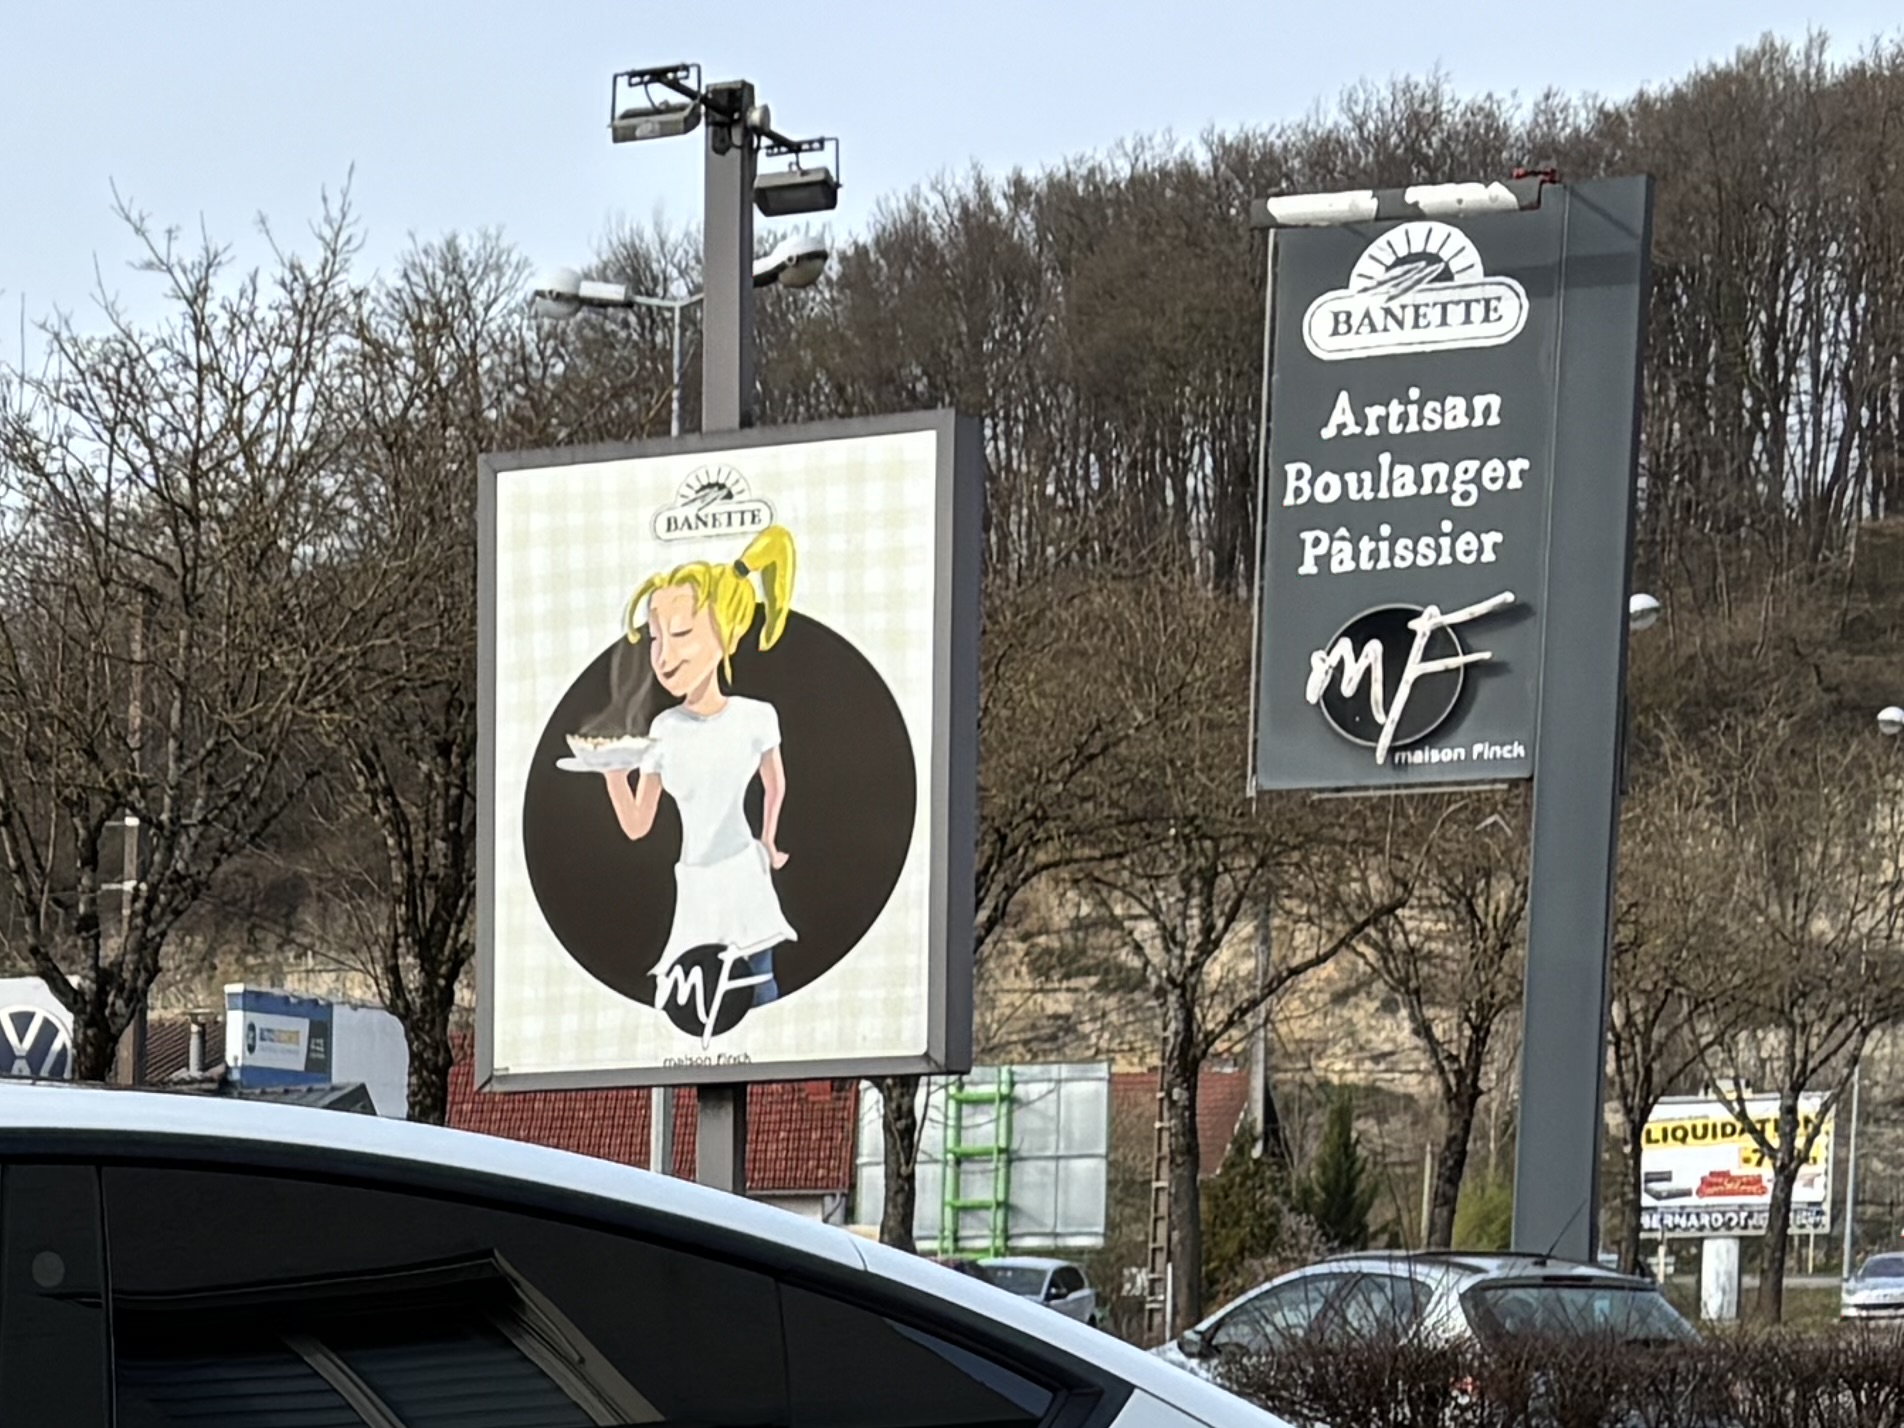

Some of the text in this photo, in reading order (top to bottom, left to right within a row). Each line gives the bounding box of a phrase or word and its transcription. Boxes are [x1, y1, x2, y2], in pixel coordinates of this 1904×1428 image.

[1328, 296, 1504, 338] BANETTE
[1320, 386, 1502, 440] Artisan
[1282, 451, 1531, 507] Boulanger
[666, 508, 762, 533] BANETTE
[1297, 519, 1504, 576] Pâtissier
